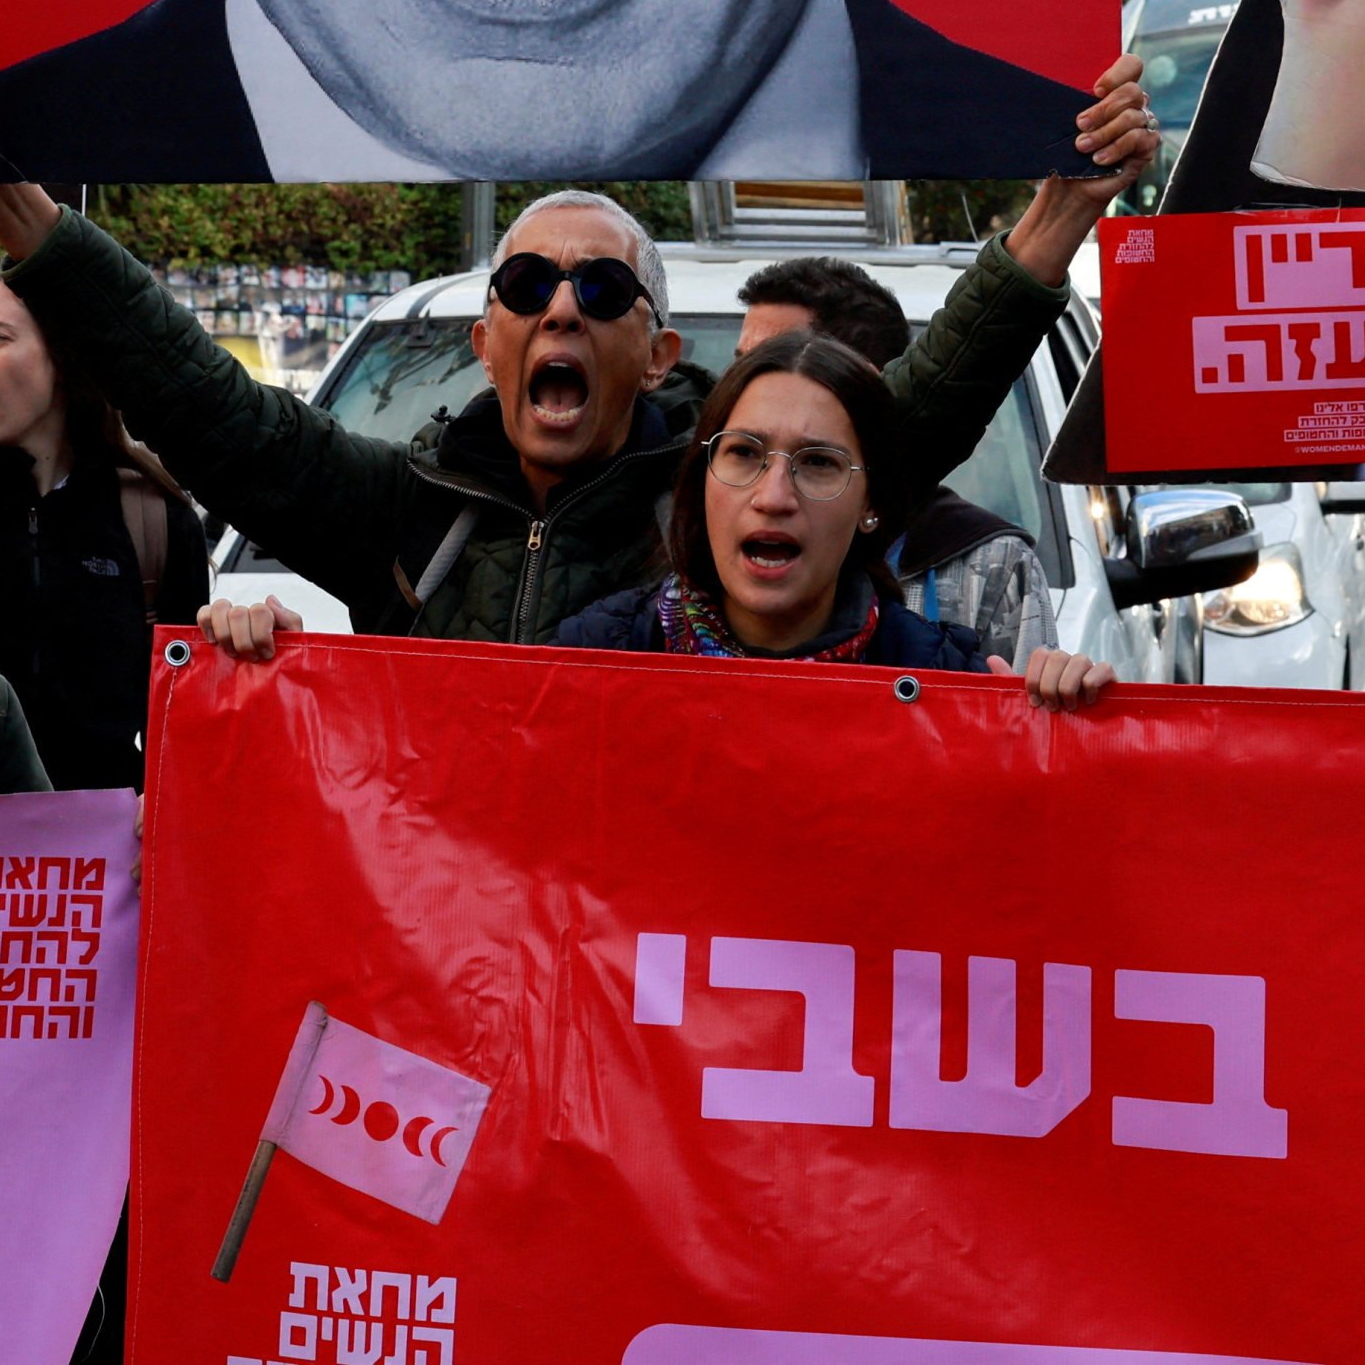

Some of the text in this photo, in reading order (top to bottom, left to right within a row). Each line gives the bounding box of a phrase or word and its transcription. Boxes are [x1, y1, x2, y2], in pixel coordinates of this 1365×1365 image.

[634, 932, 1288, 1160] בשבי
[289, 1261, 457, 1324] מחאת
[279, 1311, 455, 1365] הנשים
